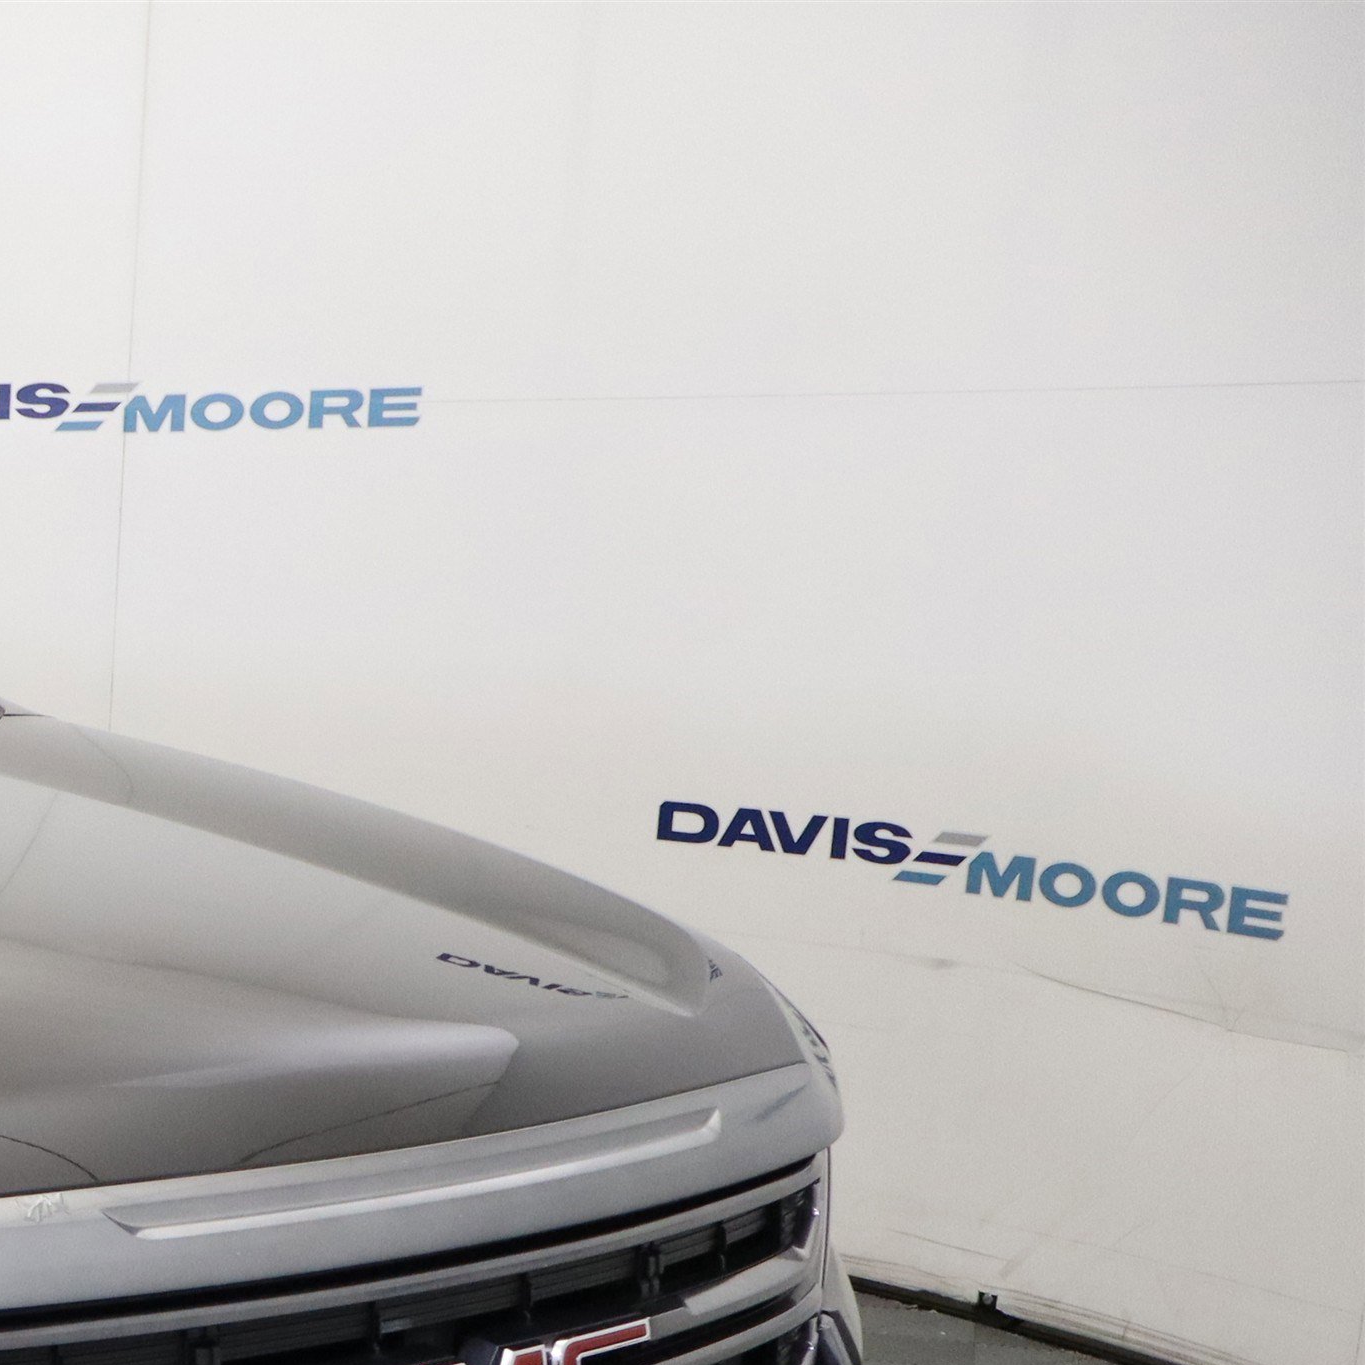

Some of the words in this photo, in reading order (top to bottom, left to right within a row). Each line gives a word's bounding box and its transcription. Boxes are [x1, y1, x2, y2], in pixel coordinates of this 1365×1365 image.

[122, 387, 423, 433] MOORE
[656, 800, 912, 866] DAVIS
[965, 850, 1289, 941] MOORE
